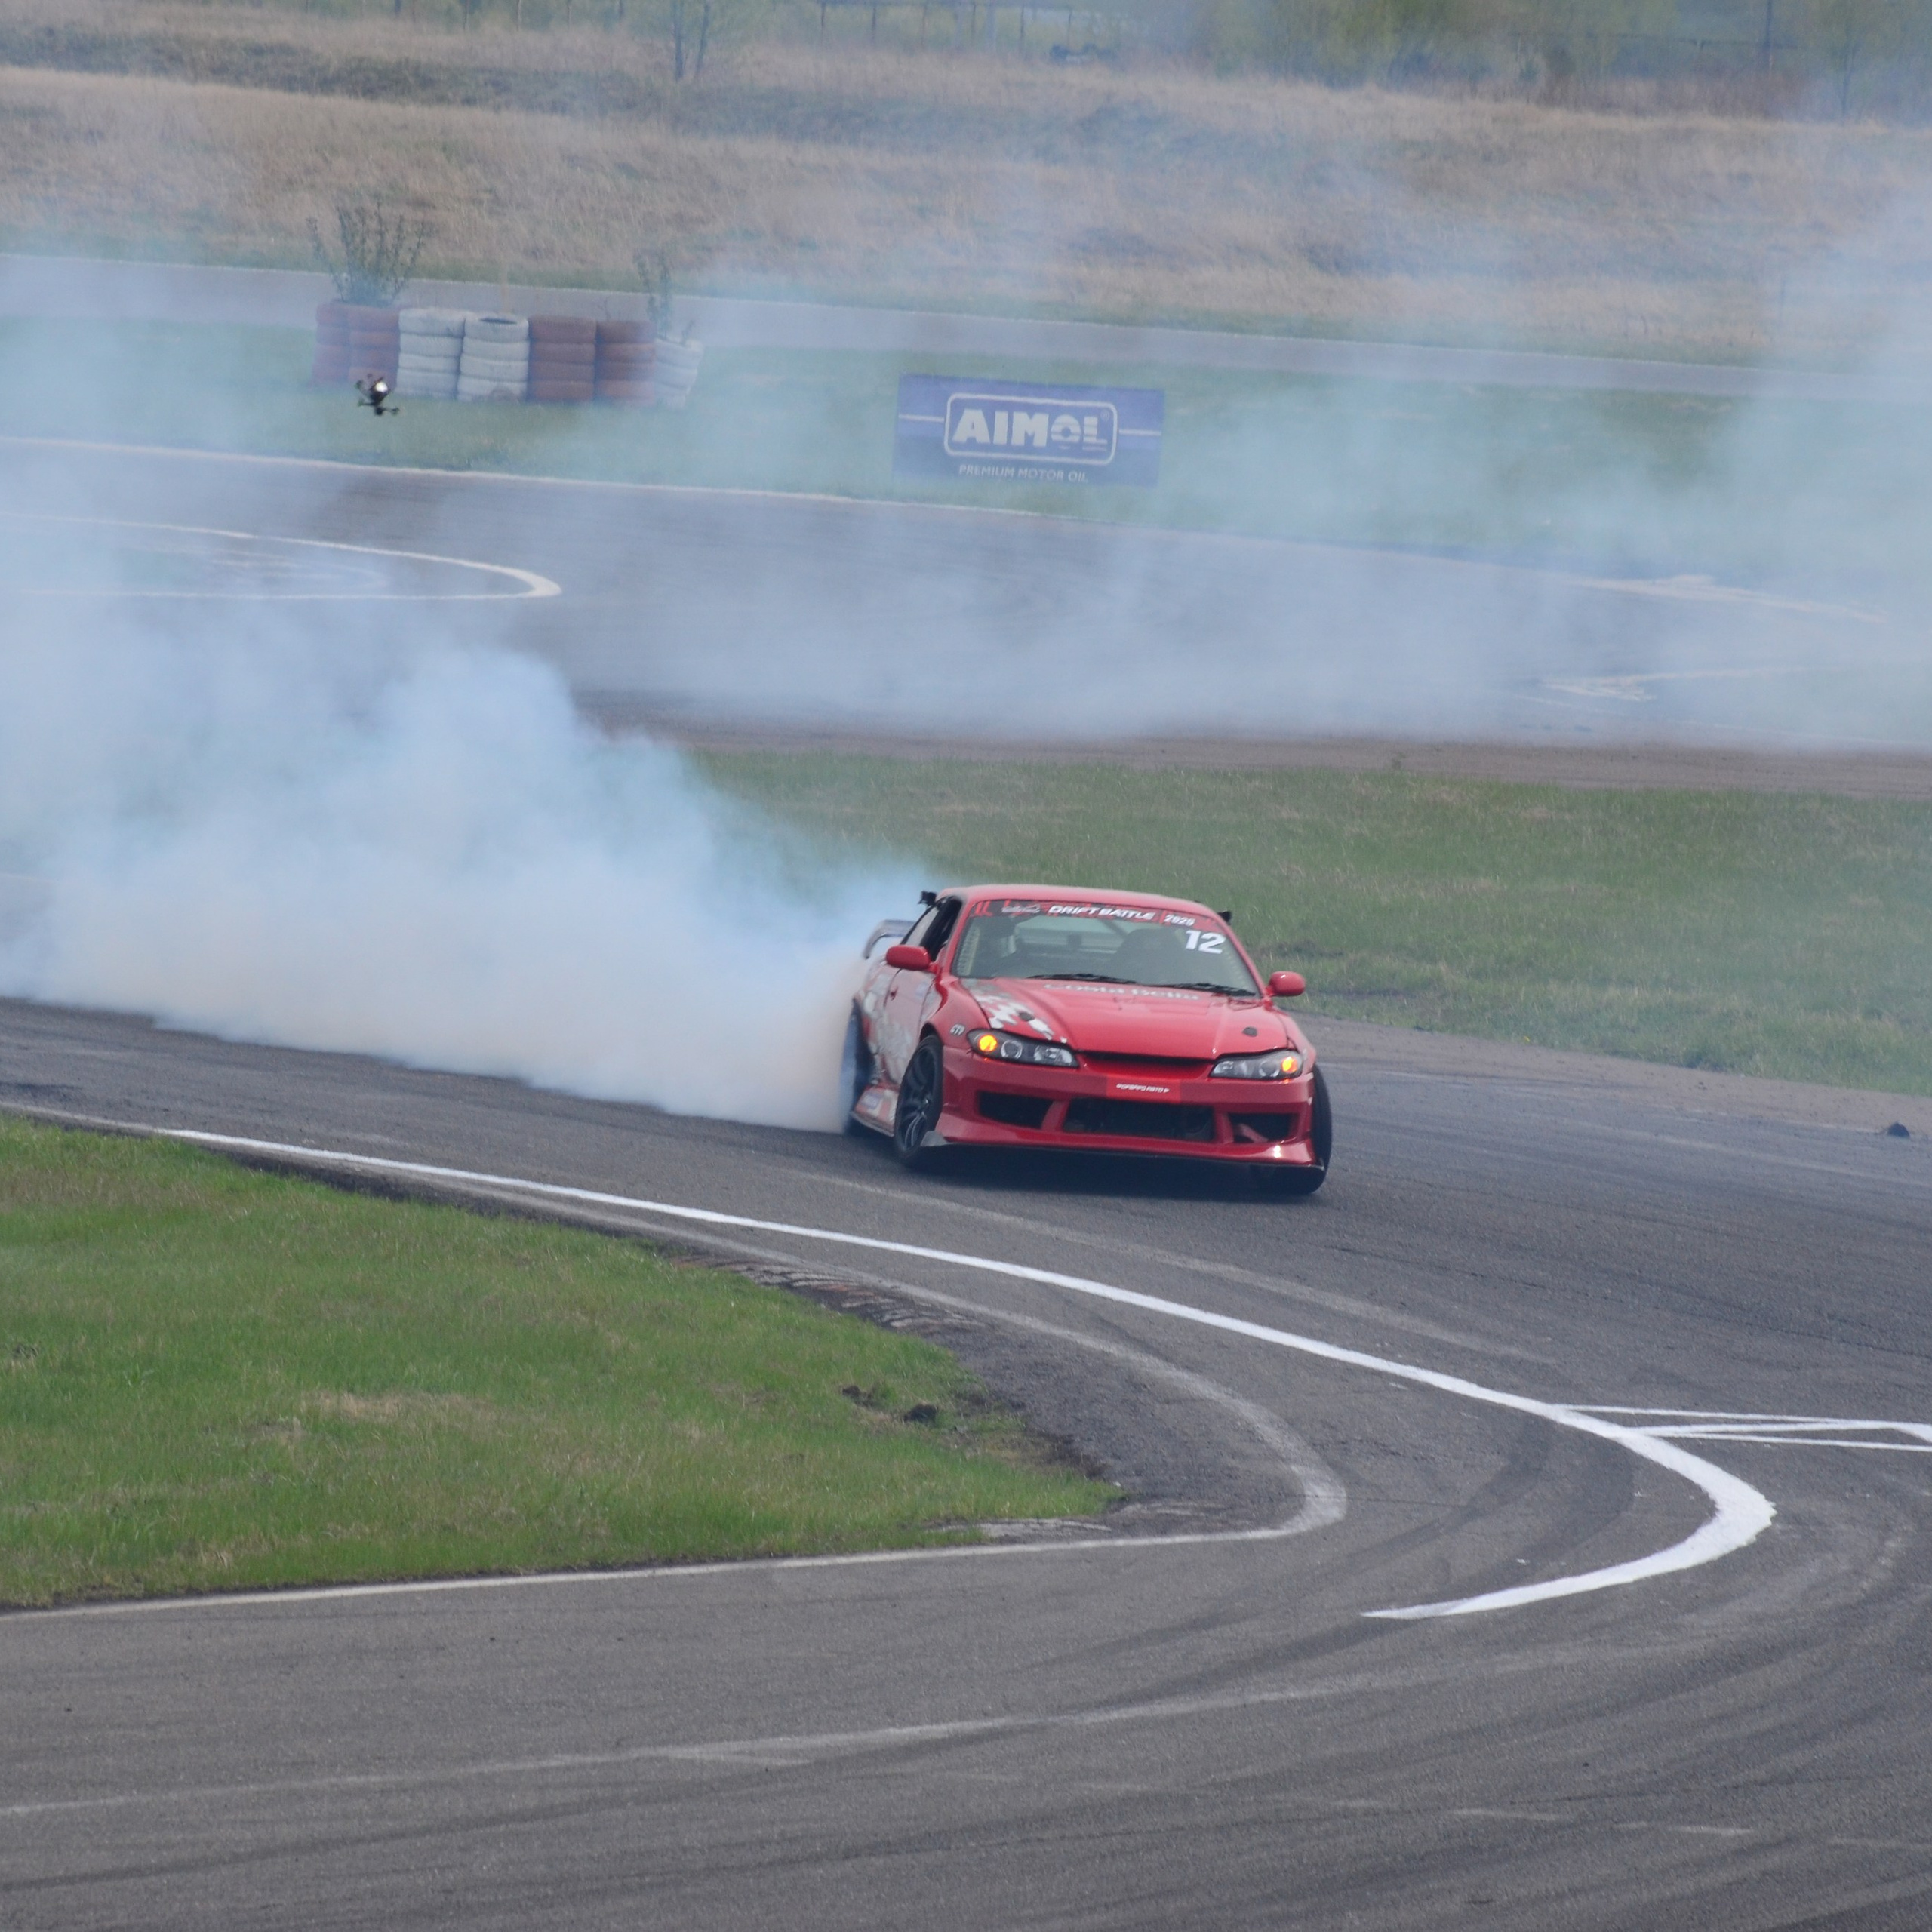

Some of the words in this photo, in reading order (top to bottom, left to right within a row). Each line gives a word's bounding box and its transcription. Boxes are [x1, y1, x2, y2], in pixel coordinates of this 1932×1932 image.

[952, 408, 1108, 450] AIMOL
[958, 463, 1016, 478] PREMIUM
[1018, 467, 1064, 481] MOTOR
[1067, 469, 1089, 483] OIL
[1048, 905, 1100, 915] DRIFT
[1098, 907, 1156, 921] BATTLE
[1186, 929, 1226, 954] 12
